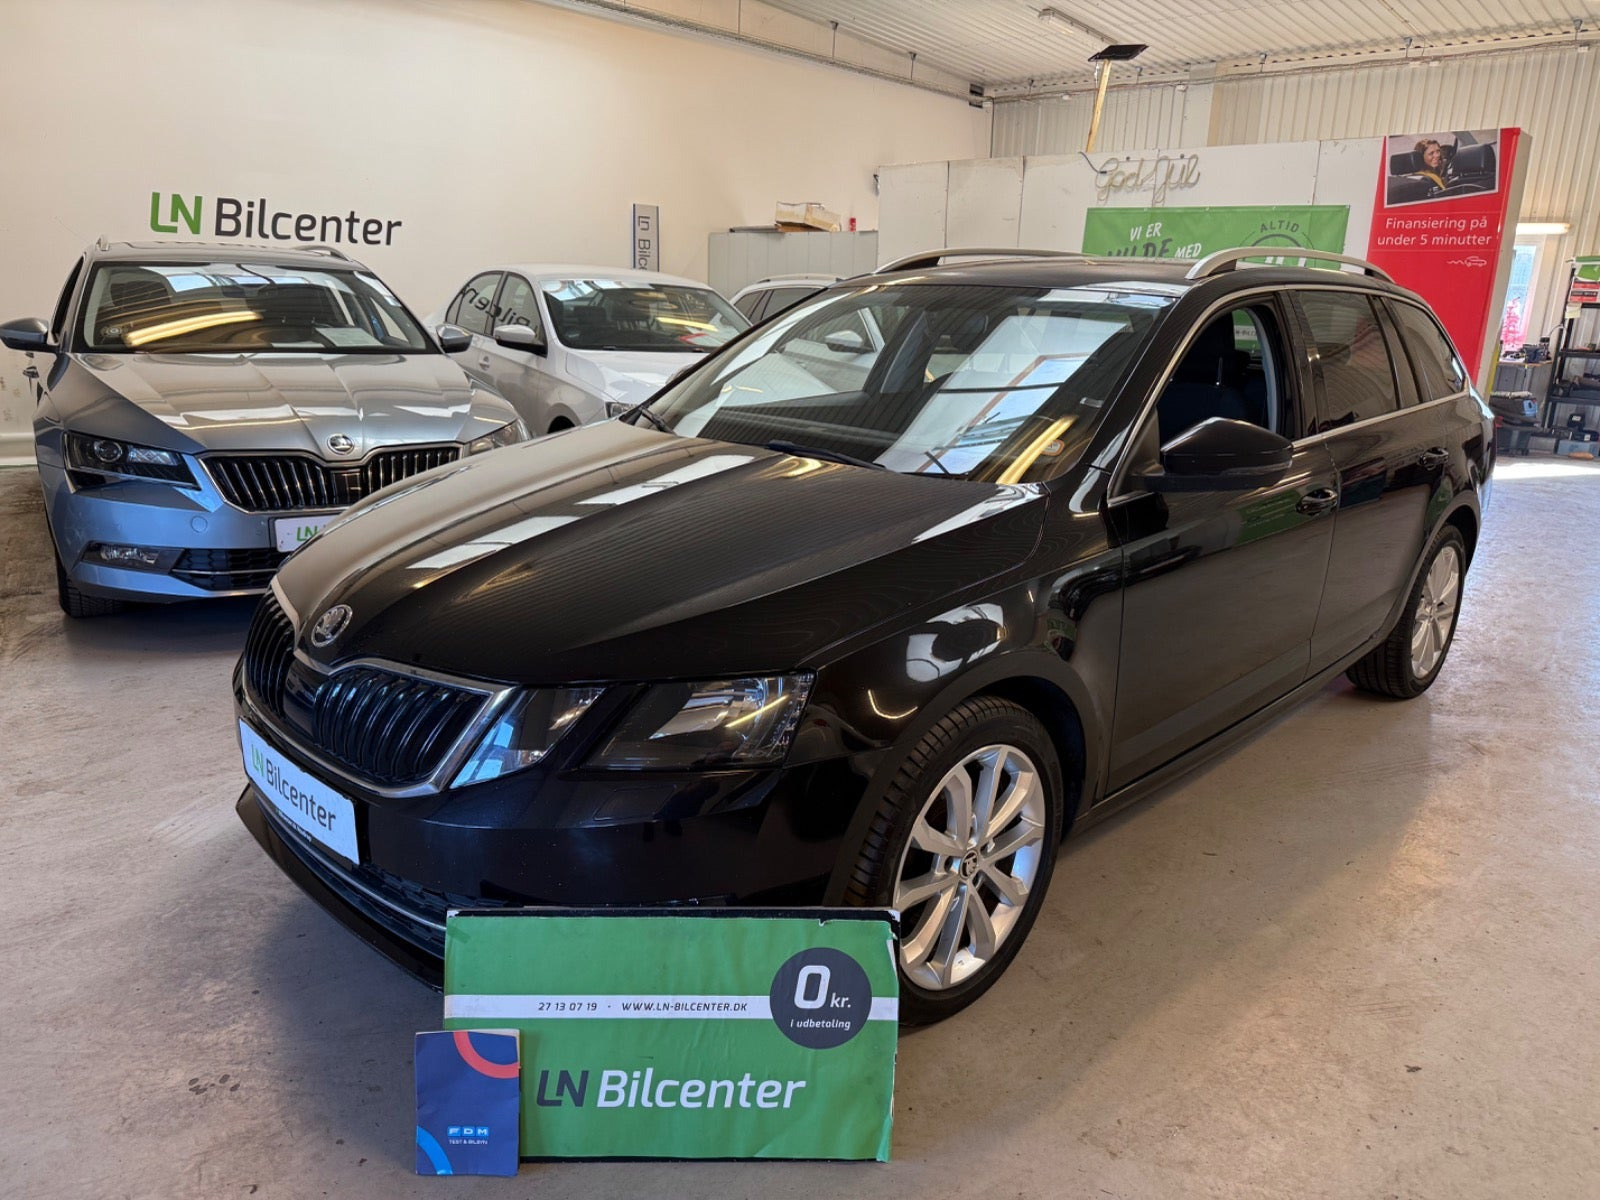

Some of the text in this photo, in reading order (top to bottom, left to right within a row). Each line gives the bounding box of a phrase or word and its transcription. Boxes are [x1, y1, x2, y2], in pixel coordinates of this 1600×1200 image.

[150, 191, 403, 246] LN Bilcenter
[1260, 220, 1300, 233] ALTID
[1385, 215, 1488, 231] Finansiering på
[1130, 222, 1162, 242] VI ER
[1377, 233, 1492, 246] under 5 minutter
[1174, 242, 1202, 259] MED
[251, 744, 265, 778] LN
[266, 757, 337, 832] Bilcenter
[794, 965, 851, 1009] 0 kr.
[538, 1002, 748, 1012] 27 13 07 19 WWW.LN-BILCENTER.DK
[796, 1019, 851, 1031] udbetaling
[537, 1067, 807, 1109] LN Bilcenter
[448, 1126, 488, 1136] FDM
